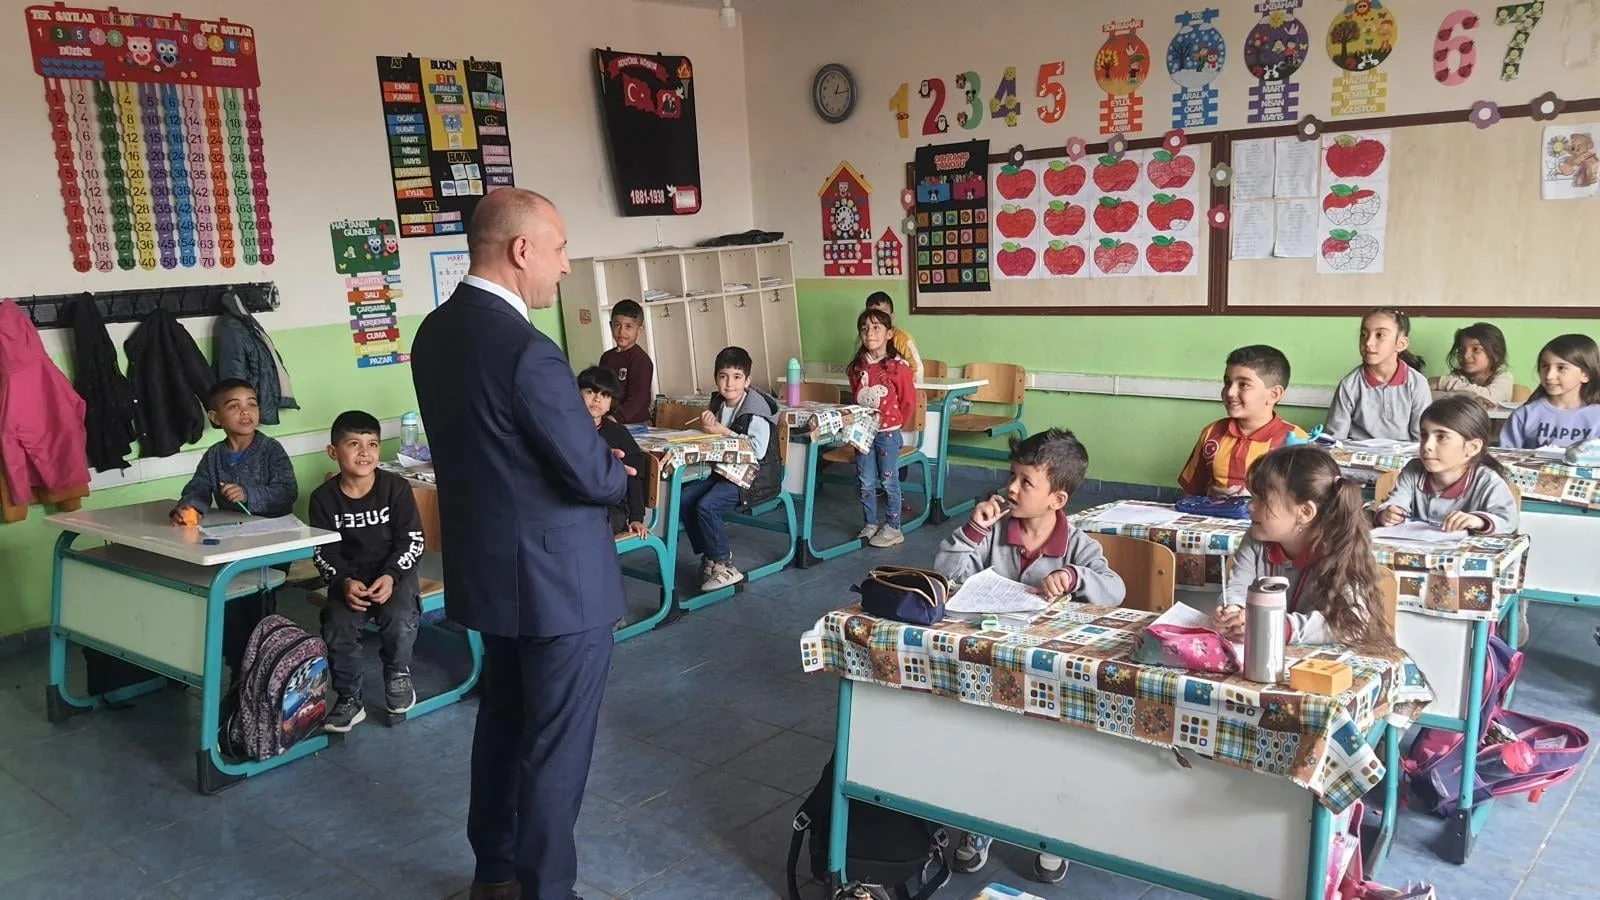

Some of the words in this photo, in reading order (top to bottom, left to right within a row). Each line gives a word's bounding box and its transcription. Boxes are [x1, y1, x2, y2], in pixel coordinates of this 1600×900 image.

[31, 10, 52, 20] TEK
[55, 12, 96, 24] SAYILAR
[38, 27, 42, 37] 1
[56, 28, 63, 38] 3
[76, 30, 82, 40] 5
[112, 33, 118, 42] 9
[182, 34, 188, 44] 0
[230, 41, 234, 49] 6
[1433, 10, 1480, 86] 6
[1495, 0, 1544, 81] 7
[391, 58, 402, 68] AY
[430, 60, 457, 70] BUGÜN
[1037, 62, 1066, 124] 5
[1182, 91, 1209, 100] ARALIK
[1262, 85, 1285, 93] MART
[53, 94, 58, 103] 1
[77, 94, 85, 104] 2
[124, 96, 131, 105] 4
[147, 97, 154, 106] 5
[169, 98, 176, 107] 6
[188, 99, 194, 108] 7
[229, 101, 236, 110] 9
[956, 71, 984, 130] 3
[990, 66, 1020, 127] 4
[1261, 99, 1284, 107] NİSAN
[890, 82, 909, 138] 1
[920, 78, 948, 136] 2
[1184, 105, 1204, 113] OCAK
[57, 112, 64, 120] 2
[81, 114, 88, 122] 4
[127, 115, 134, 124] 8
[147, 115, 159, 125] 10
[169, 115, 181, 125] 12
[189, 117, 199, 126] 14
[230, 119, 240, 128] 18
[60, 131, 67, 140] 3
[83, 132, 90, 140] 6
[126, 133, 138, 143] 12
[149, 133, 161, 143] 15
[172, 134, 182, 143] 18
[190, 135, 202, 143] 21
[231, 136, 242, 145] 27
[62, 151, 69, 159] 4
[86, 151, 92, 160] 8
[128, 152, 140, 160] 16
[151, 152, 164, 160] 20
[173, 152, 184, 160] 24
[192, 153, 204, 162] 28
[232, 154, 244, 162] 36
[447, 152, 471, 163] HAVA
[65, 170, 72, 178] 5
[86, 170, 98, 178] 10
[130, 170, 144, 178] 20
[154, 170, 166, 178] 25
[174, 169, 187, 178] 30
[193, 170, 206, 179] 35
[234, 171, 248, 179] 45
[69, 187, 75, 196] 6
[89, 187, 100, 196] 12
[133, 188, 147, 196] 24
[155, 187, 168, 195] 30
[177, 186, 190, 195] 36
[195, 188, 208, 197] 42
[238, 187, 250, 196] 54
[630, 189, 665, 205] 1881-1938
[72, 206, 78, 214] 7
[92, 206, 104, 214] 14
[136, 204, 149, 213] 28
[158, 205, 171, 213] 35
[178, 205, 190, 213] 42
[197, 206, 210, 214] 49
[240, 205, 252, 213] 63
[423, 200, 440, 212] YIL
[75, 225, 81, 233] 8
[95, 225, 106, 233] 16
[138, 223, 151, 231] 32
[200, 223, 213, 232] 56
[243, 221, 253, 230] 72
[331, 220, 370, 230] HAFTANIN
[344, 227, 376, 236] GÜNLERİ
[79, 242, 85, 250] 9
[98, 242, 109, 251] 18
[140, 240, 153, 249] 36
[161, 240, 174, 248] 45
[181, 238, 194, 246] 54
[200, 240, 214, 249] 63
[245, 238, 256, 246] 81
[100, 261, 113, 269] 20
[141, 259, 156, 267] 40
[163, 258, 177, 267] 50
[183, 256, 196, 264] 60
[202, 258, 215, 267] 70
[245, 255, 258, 263] 90
[369, 356, 393, 365] PAZAR
[1537, 422, 1592, 440] HAPPY
